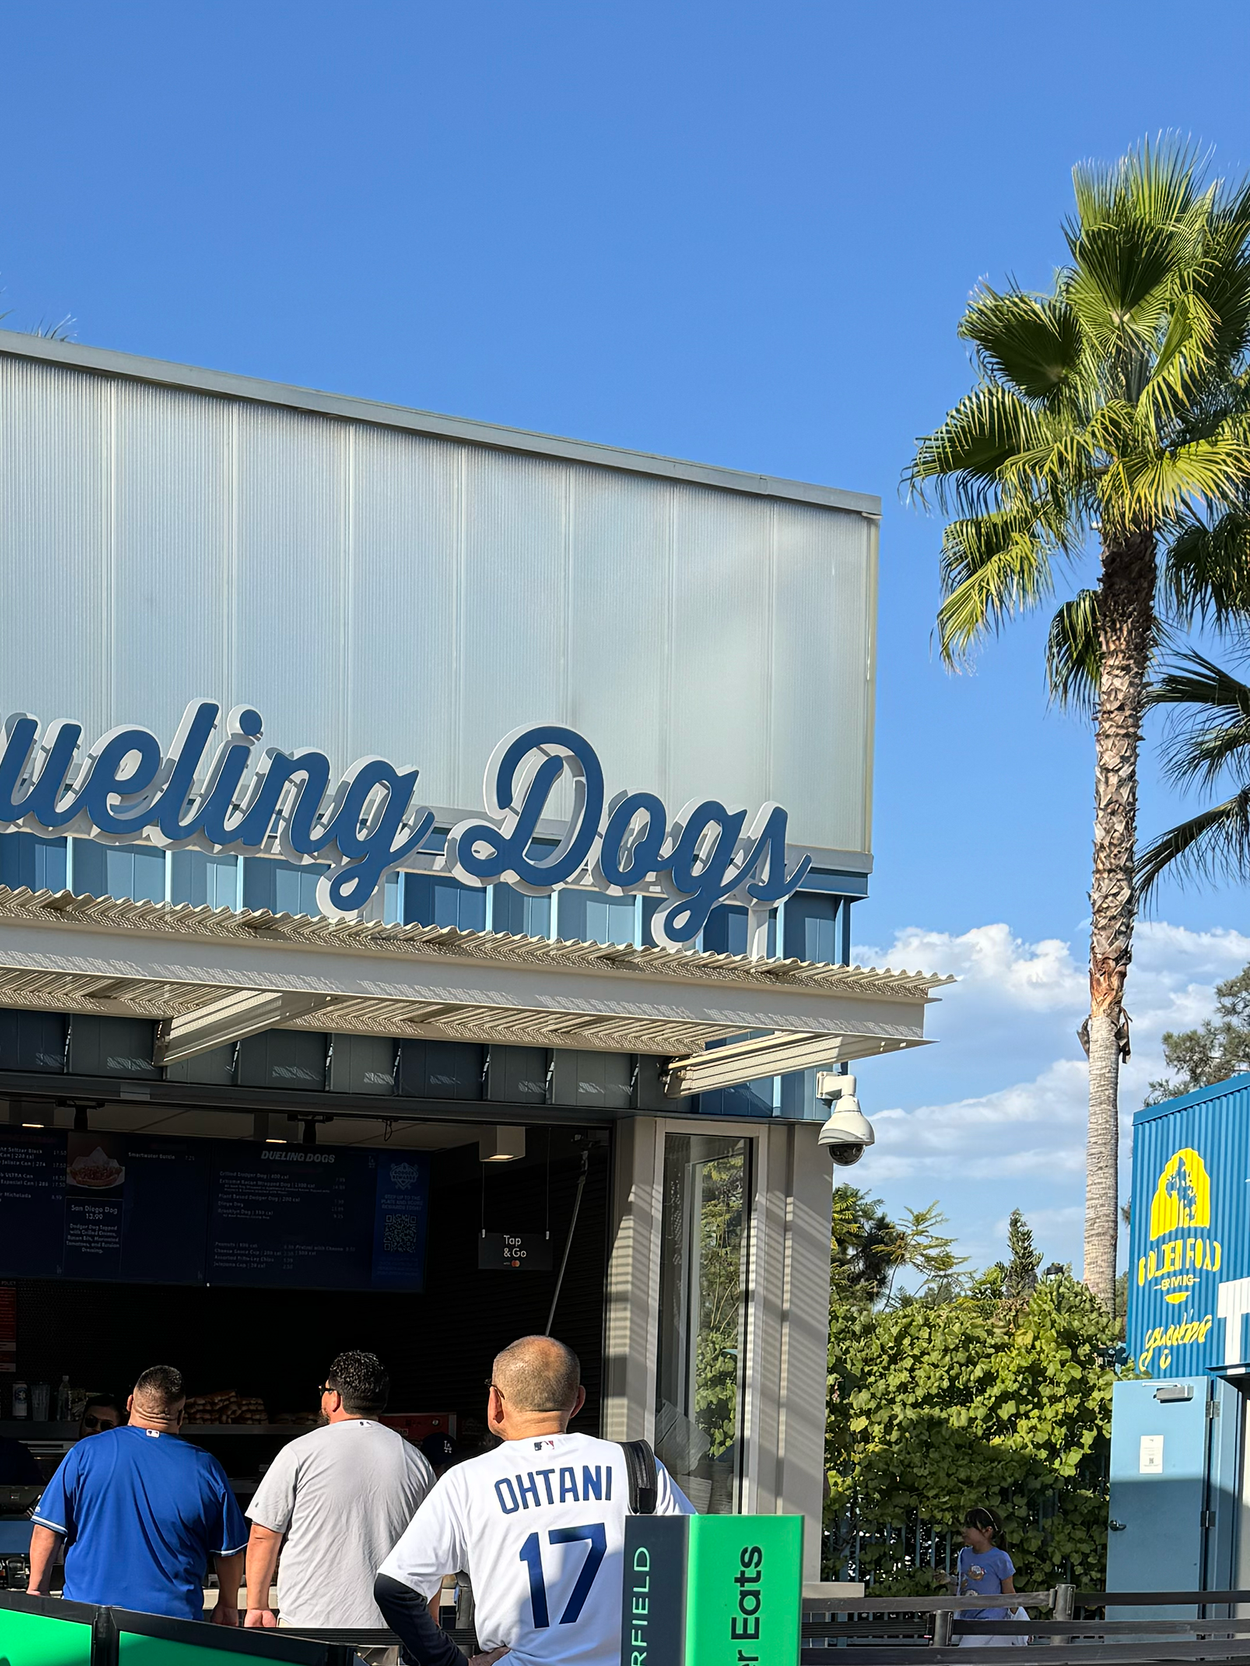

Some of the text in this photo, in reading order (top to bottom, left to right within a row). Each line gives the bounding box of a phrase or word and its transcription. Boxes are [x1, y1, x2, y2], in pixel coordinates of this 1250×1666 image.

[448, 722, 809, 948] Dogs
[261, 1150, 335, 1163] DUELING DOGS
[503, 1235, 521, 1247] Tap
[504, 1248, 527, 1257] & Go
[495, 1466, 612, 1515] OHTANI
[519, 1522, 608, 1629] 17
[731, 1545, 763, 1640] Eats
